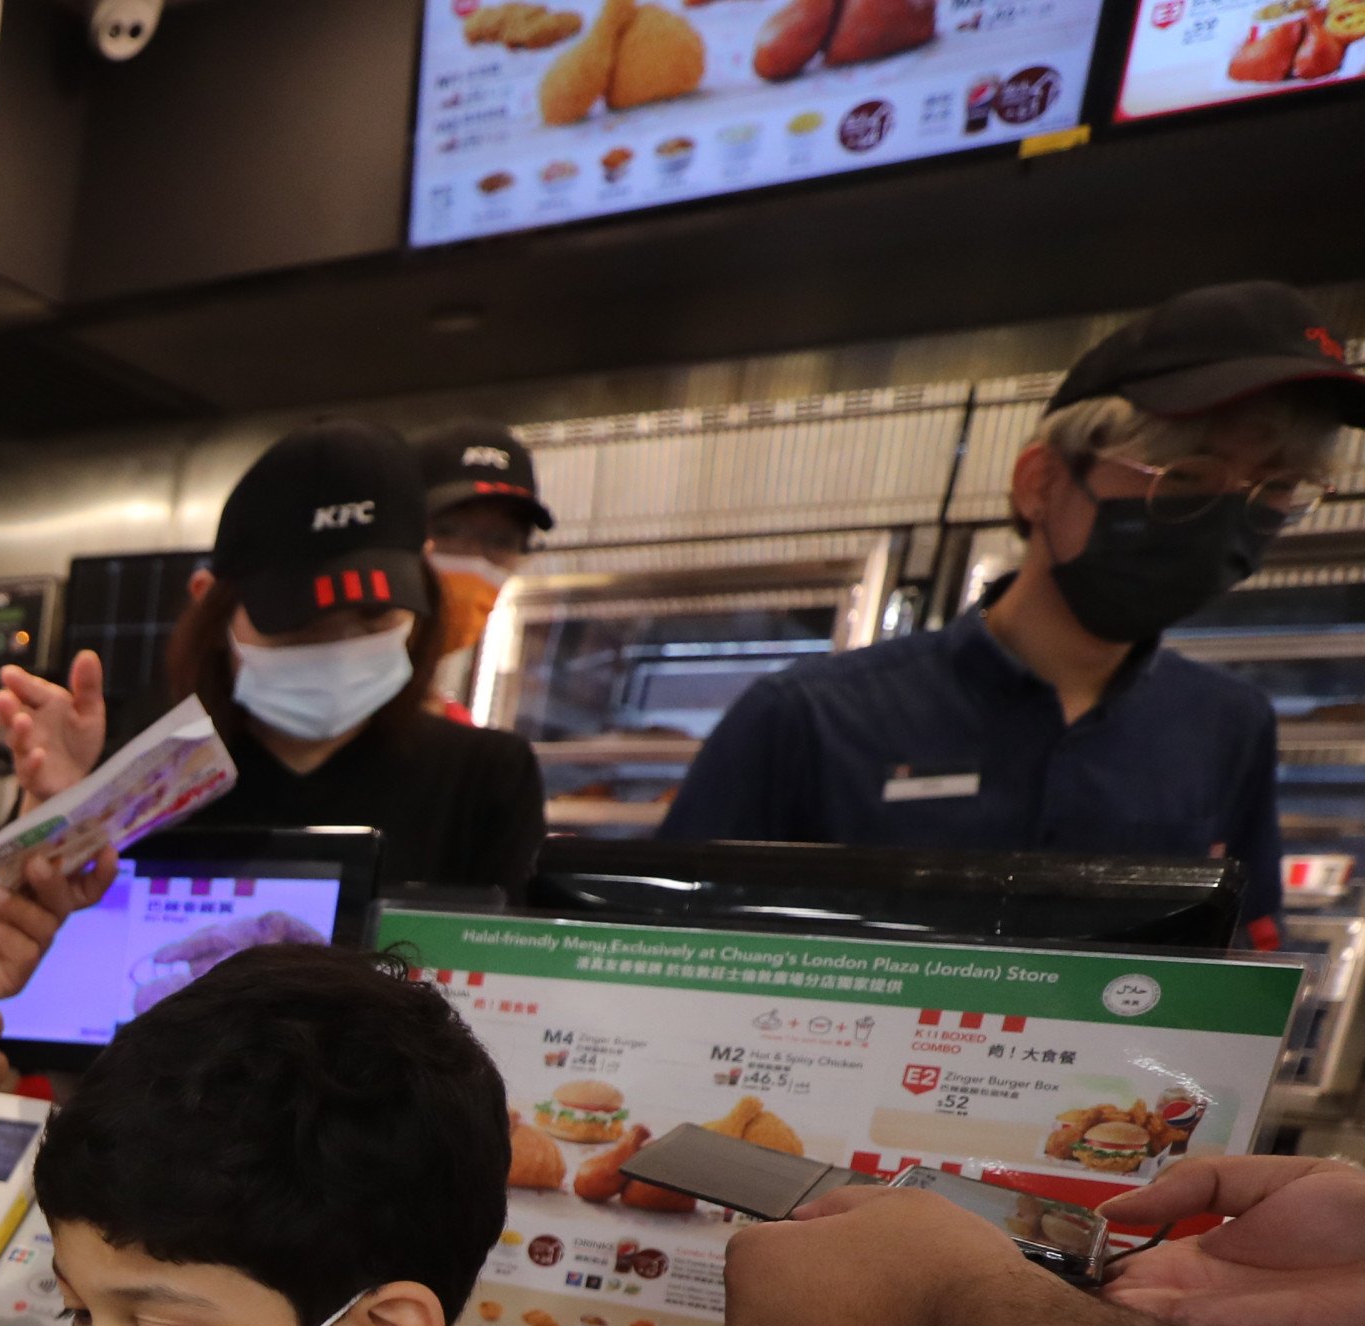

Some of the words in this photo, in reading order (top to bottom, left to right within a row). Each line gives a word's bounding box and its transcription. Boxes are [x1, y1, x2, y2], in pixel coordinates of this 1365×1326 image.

[462, 445, 511, 471] KFC
[311, 500, 376, 531] KFC
[462, 929, 559, 951] Halal-friendly
[563, 935, 606, 953] Menu
[610, 938, 695, 961] Exclusively
[698, 947, 716, 960] at
[720, 946, 797, 968] Chuang's
[801, 952, 868, 970] London
[872, 957, 919, 973] Plaza
[924, 961, 1002, 981] (Jordan)
[1006, 966, 1059, 983] Store
[543, 1028, 574, 1045] M4
[911, 1041, 962, 1055] COMBO
[710, 1045, 746, 1063] M2
[818, 1056, 864, 1070] Chicken
[905, 1068, 937, 1087] E2
[945, 1071, 984, 1085] Zinger
[989, 1076, 1031, 1090] Burger
[1034, 1080, 1060, 1091] Box
[937, 1094, 970, 1110] $52
